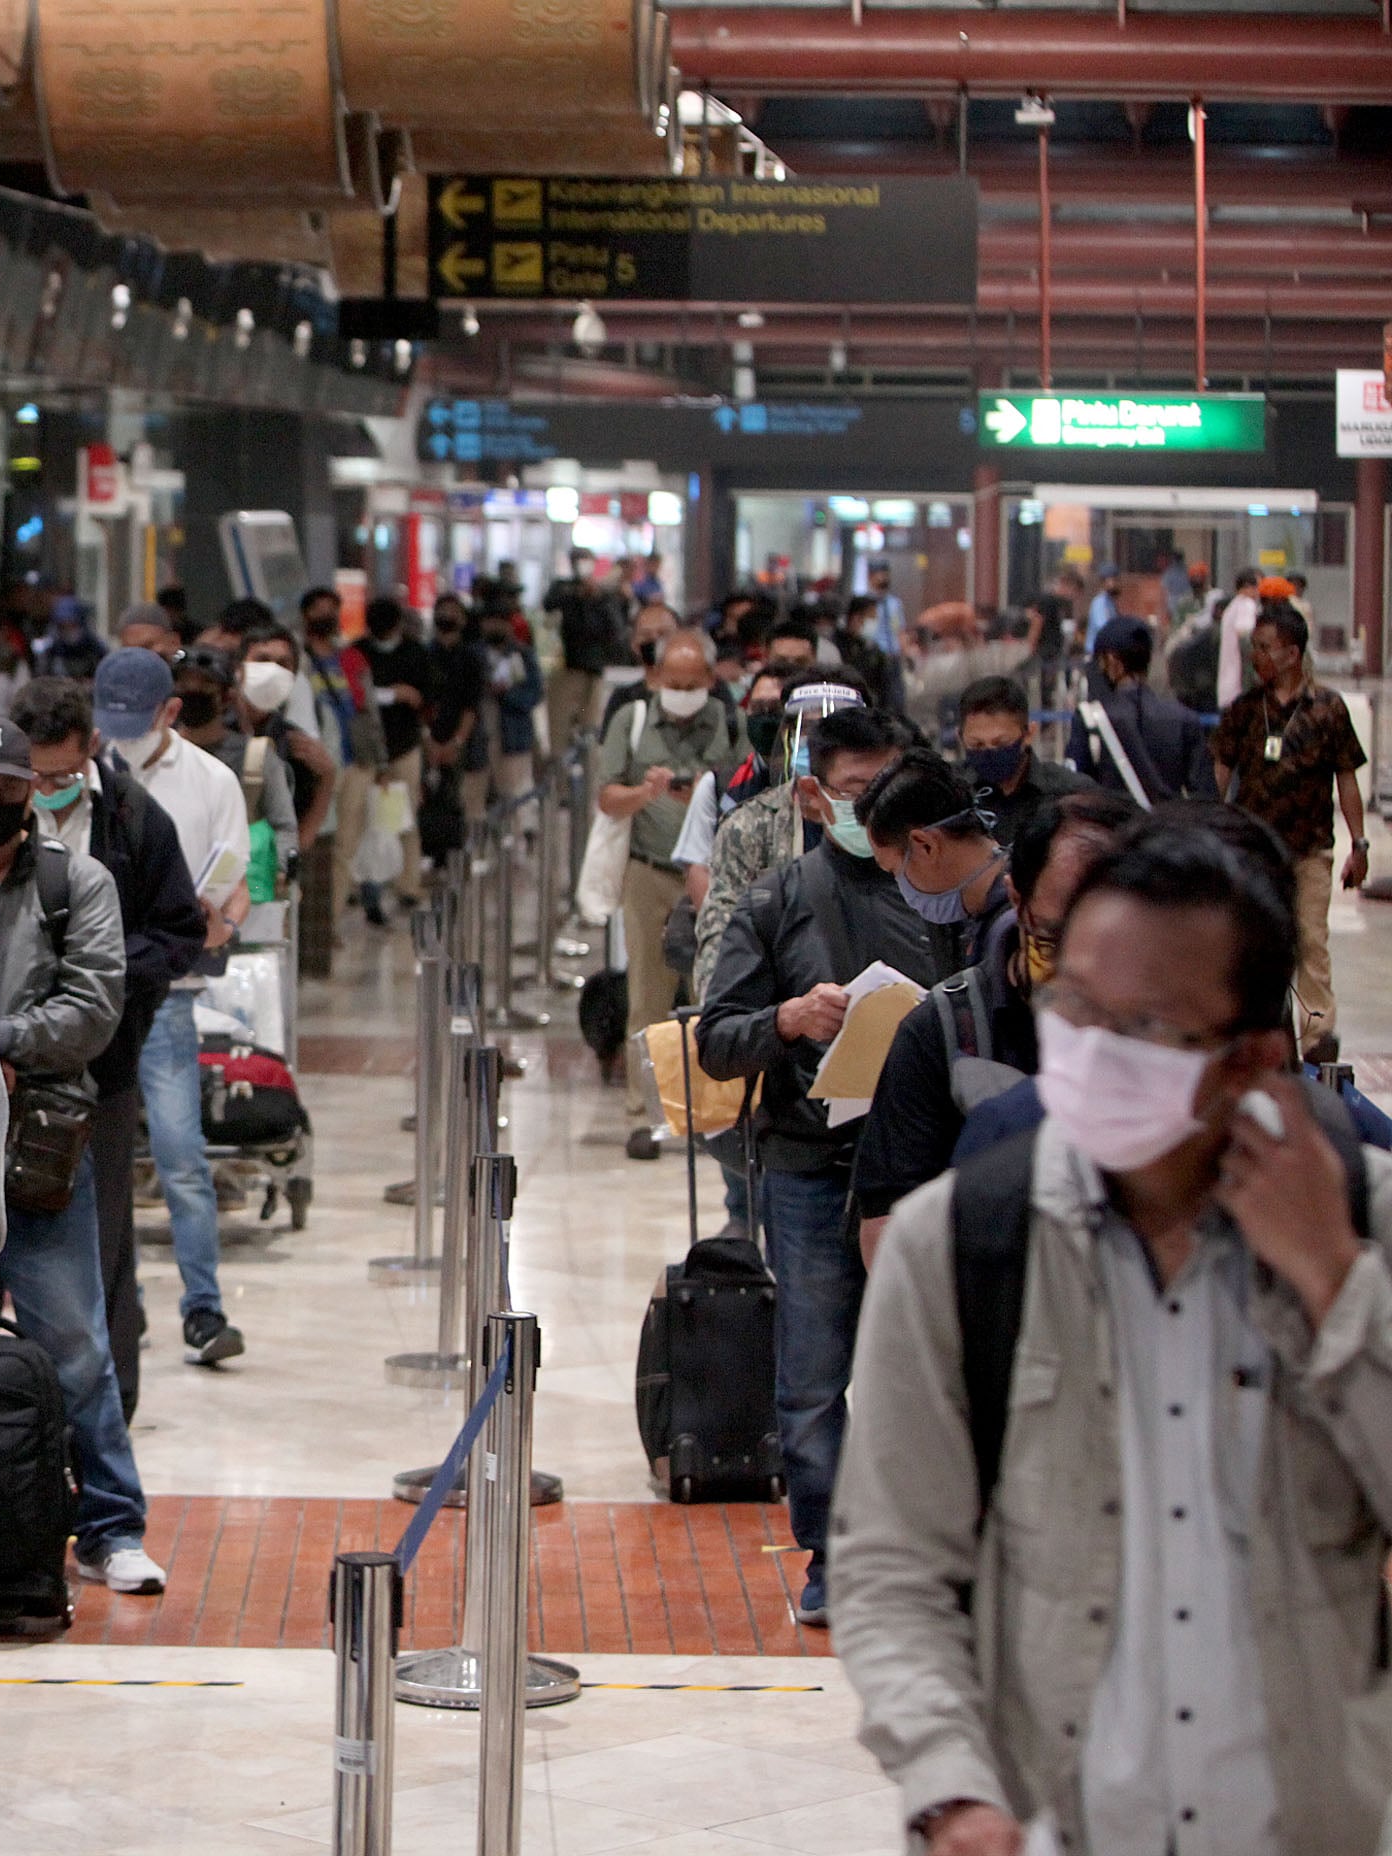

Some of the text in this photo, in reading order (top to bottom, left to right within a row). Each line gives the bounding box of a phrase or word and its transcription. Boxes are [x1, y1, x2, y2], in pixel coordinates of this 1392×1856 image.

[731, 183, 880, 207] Internasional
[549, 208, 828, 235] International Departures
[616, 252, 637, 284] 5
